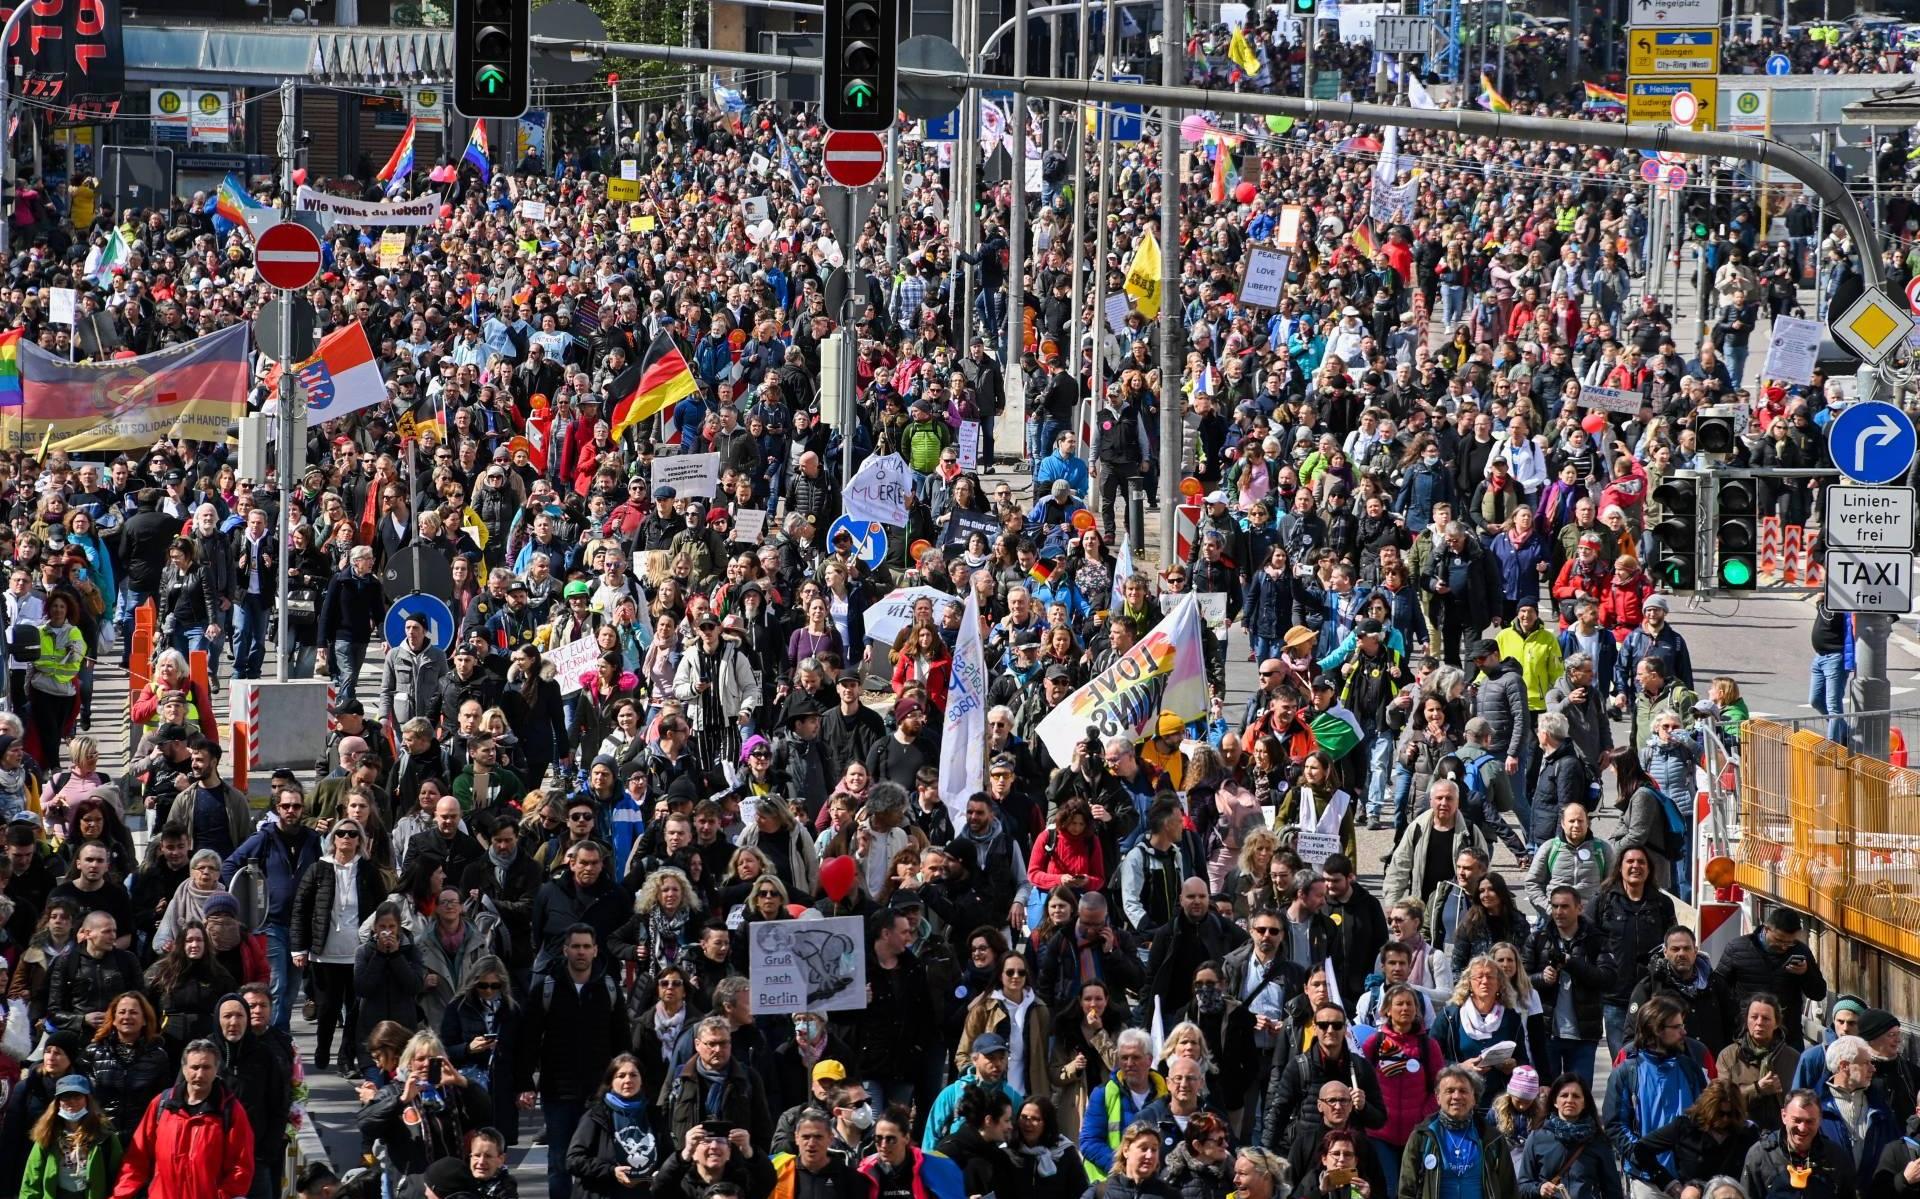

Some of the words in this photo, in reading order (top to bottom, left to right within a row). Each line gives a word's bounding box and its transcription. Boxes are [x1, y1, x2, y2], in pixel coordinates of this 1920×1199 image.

[1655, 48, 1694, 58] Tübingen
[1657, 61, 1687, 70] City-Ring
[1690, 61, 1709, 69] (West)
[1638, 100, 1672, 109] Ludwigs
[613, 185, 634, 194] Berlin
[304, 198, 328, 212] Wie
[1257, 250, 1281, 260] PEACE
[1256, 267, 1276, 276] LOVE
[1247, 282, 1277, 293] LIBERTY
[876, 470, 886, 480] O
[851, 481, 904, 505] MUERTE
[1843, 494, 1898, 507] Linien-
[1840, 511, 1900, 525] verkehr
[959, 518, 971, 528] Die
[985, 523, 997, 532] der
[1857, 528, 1883, 541] frei
[1838, 562, 1899, 586] TAXI
[1856, 592, 1882, 604] frei
[764, 954, 792, 965] Gruß
[765, 972, 791, 983] nach
[760, 991, 798, 1005] Berlin
